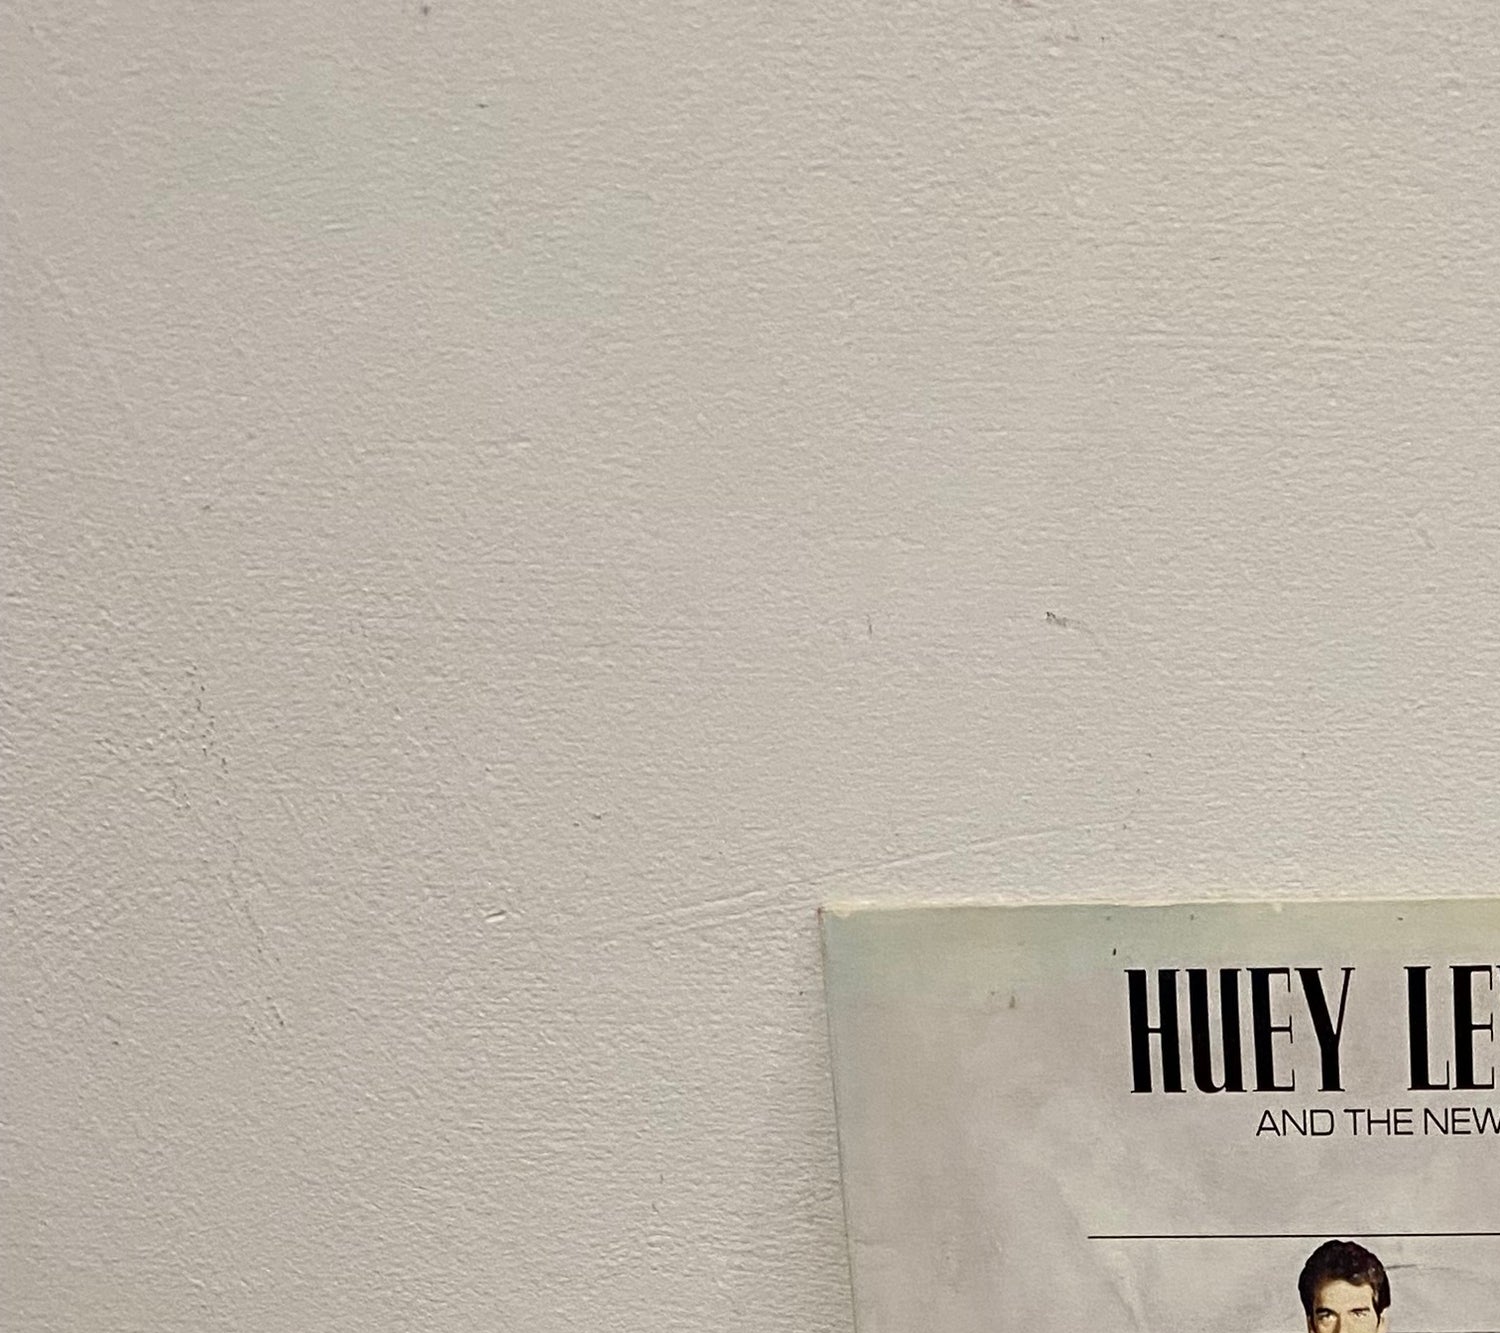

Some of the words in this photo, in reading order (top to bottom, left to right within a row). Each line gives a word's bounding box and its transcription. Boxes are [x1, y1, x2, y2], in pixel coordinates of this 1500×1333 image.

[1124, 967, 1355, 1094] HUEY
[1256, 1109, 1335, 1137] AND
[1344, 1108, 1414, 1135] THE
